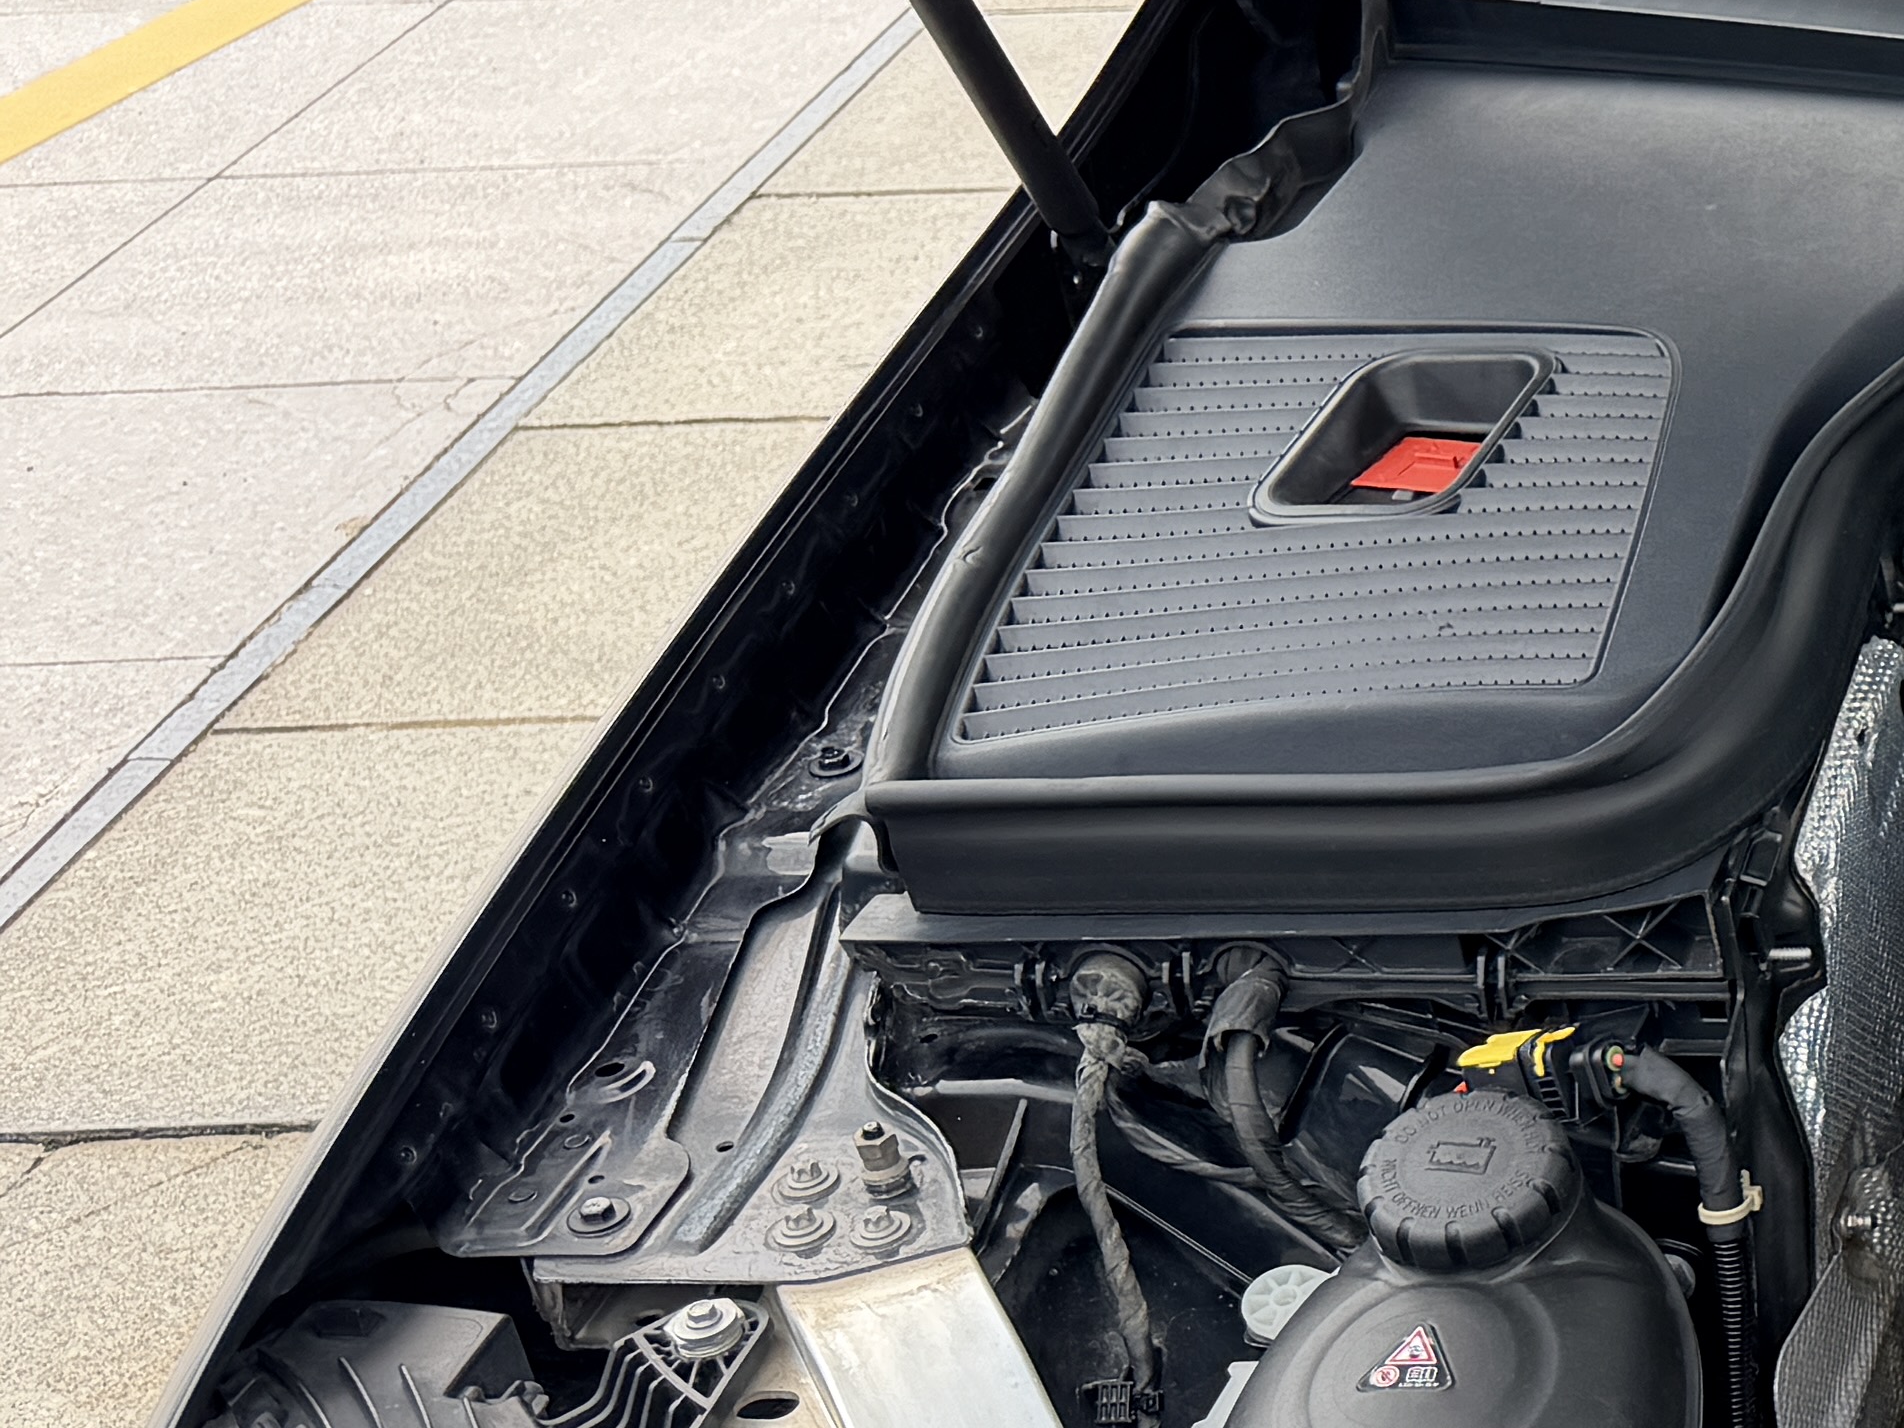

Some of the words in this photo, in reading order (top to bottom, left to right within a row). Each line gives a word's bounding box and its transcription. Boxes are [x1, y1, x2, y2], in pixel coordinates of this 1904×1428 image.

[1417, 1105, 1446, 1127] NOT
[1452, 1099, 1495, 1113] OPEN
[1493, 1169, 1529, 1202] HEISS
